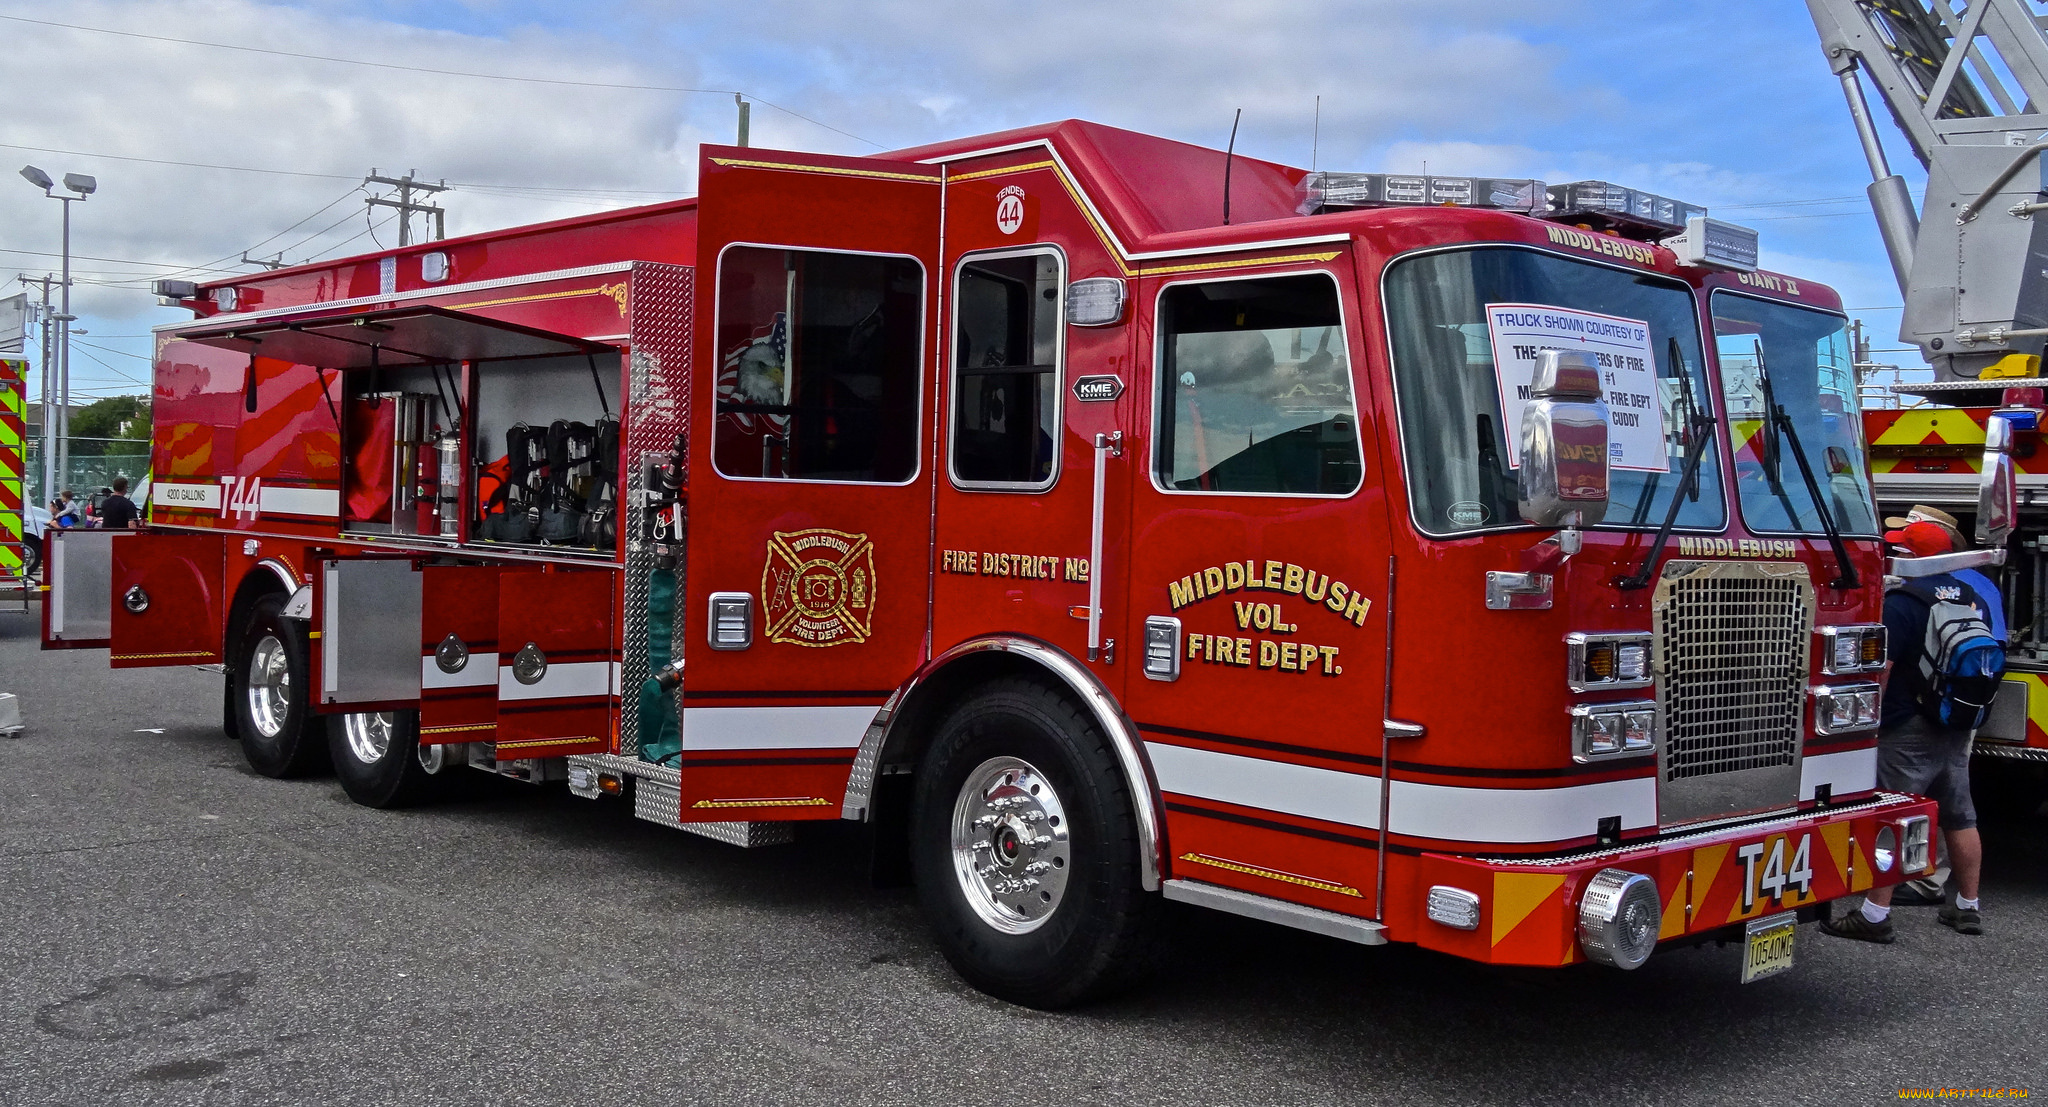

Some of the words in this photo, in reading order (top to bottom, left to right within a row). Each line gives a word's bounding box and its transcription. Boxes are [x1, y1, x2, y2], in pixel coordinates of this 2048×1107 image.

[996, 185, 1025, 202] TENDER
[1000, 201, 1019, 226] 44
[1545, 225, 1656, 266] MIDDLEBUSH
[1737, 272, 1782, 293] GIANT
[1784, 279, 1800, 296] II
[1495, 313, 1542, 328] TRUCK
[1544, 315, 1584, 332] SHOWN
[1586, 321, 1631, 340] COURTESY
[1634, 328, 1645, 341] OF
[1513, 345, 1537, 360] THE
[1614, 354, 1625, 369] OF
[1626, 356, 1646, 372] FIRE
[1080, 383, 1112, 393] KME
[1605, 371, 1616, 386] #1
[1610, 391, 1629, 407] FIRE
[1630, 394, 1651, 410] DEPT
[1612, 411, 1639, 427] CUDDY
[167, 488, 180, 500] 4200
[181, 489, 206, 501] GALLONS
[221, 475, 261, 521] T44
[792, 535, 850, 554] MIDDLEBUSH
[1678, 536, 1797, 558] MIDDLEBUSH
[942, 549, 978, 573] FIRE
[982, 552, 1060, 579] DISTRICT
[1168, 559, 1372, 627] MIDDLEBUSH
[798, 617, 841, 631] VOLUNTEER
[1233, 600, 1298, 633] VOL.
[791, 624, 815, 641] FIRE
[817, 625, 848, 641] DEPT.
[1187, 632, 1252, 666] FIRE
[1258, 639, 1344, 676] DEPT.
[1737, 833, 1813, 908] T44
[1749, 933, 1793, 968] 10540MG
